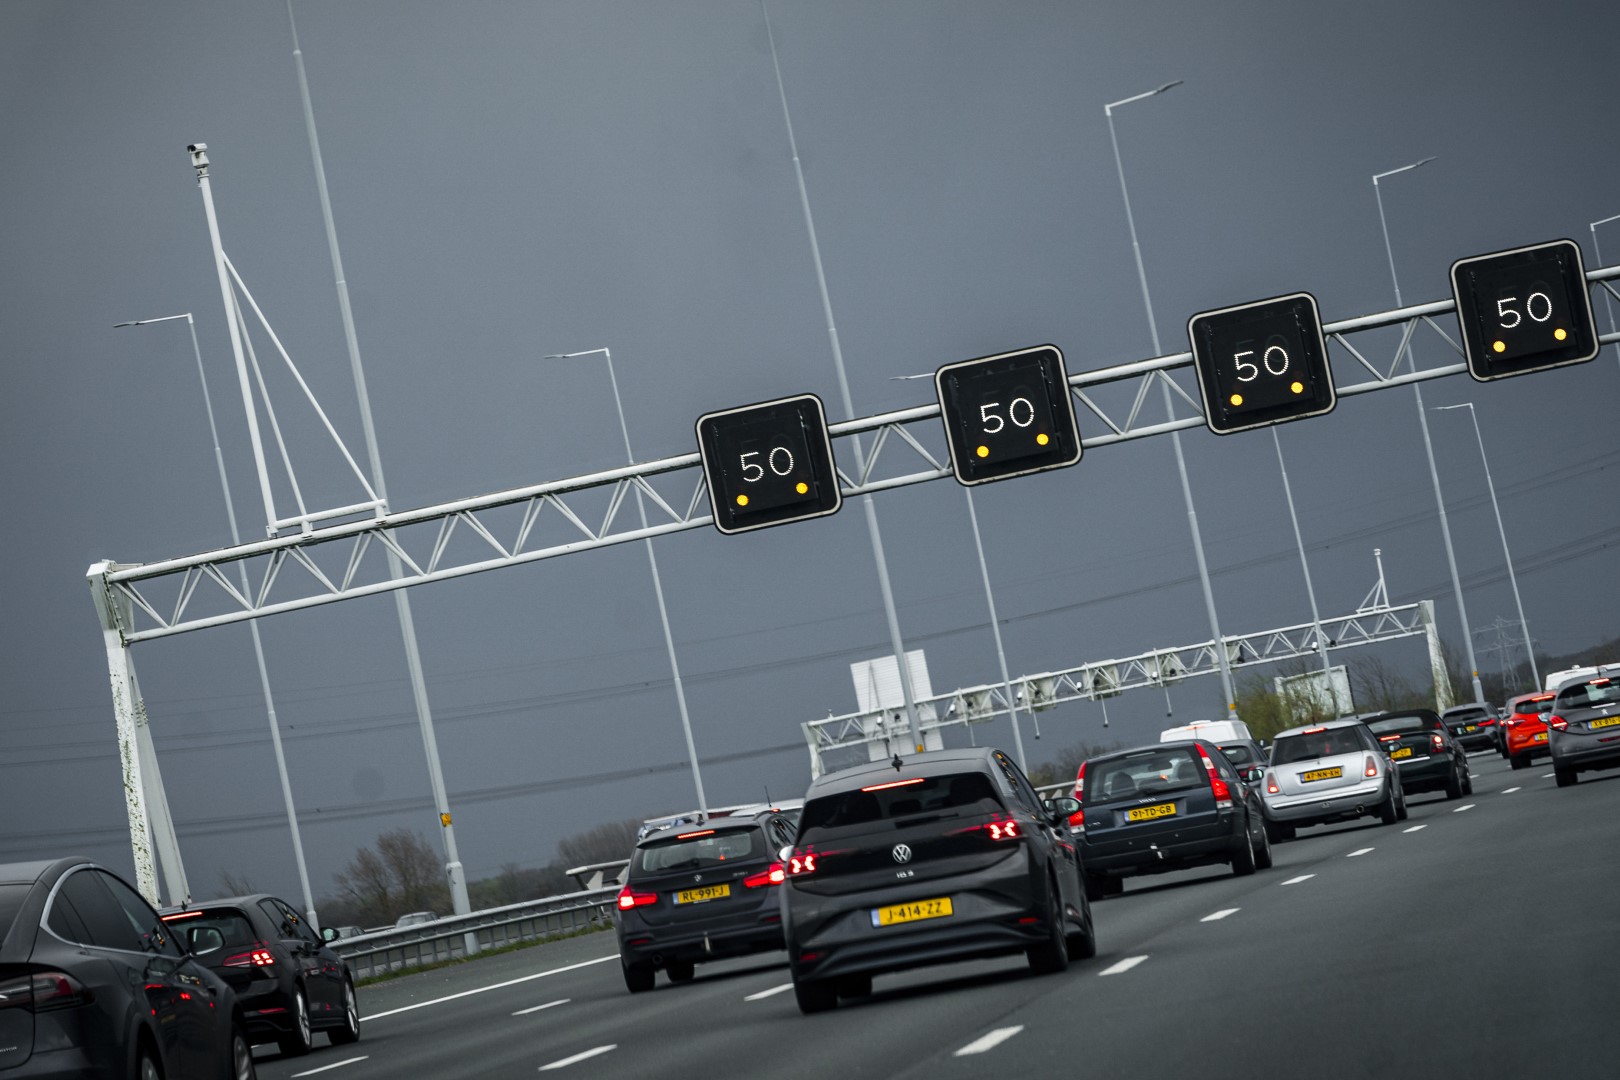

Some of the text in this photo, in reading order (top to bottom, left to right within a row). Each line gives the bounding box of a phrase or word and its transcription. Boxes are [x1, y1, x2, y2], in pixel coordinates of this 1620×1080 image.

[1497, 292, 1553, 328] 50
[1233, 345, 1289, 382] 50
[980, 397, 1036, 435] 50
[740, 446, 794, 483] 50
[1132, 805, 1172, 818] 91-TD-GB
[682, 886, 724, 902] RL-991-J
[886, 901, 942, 923] J-414-ZZ
